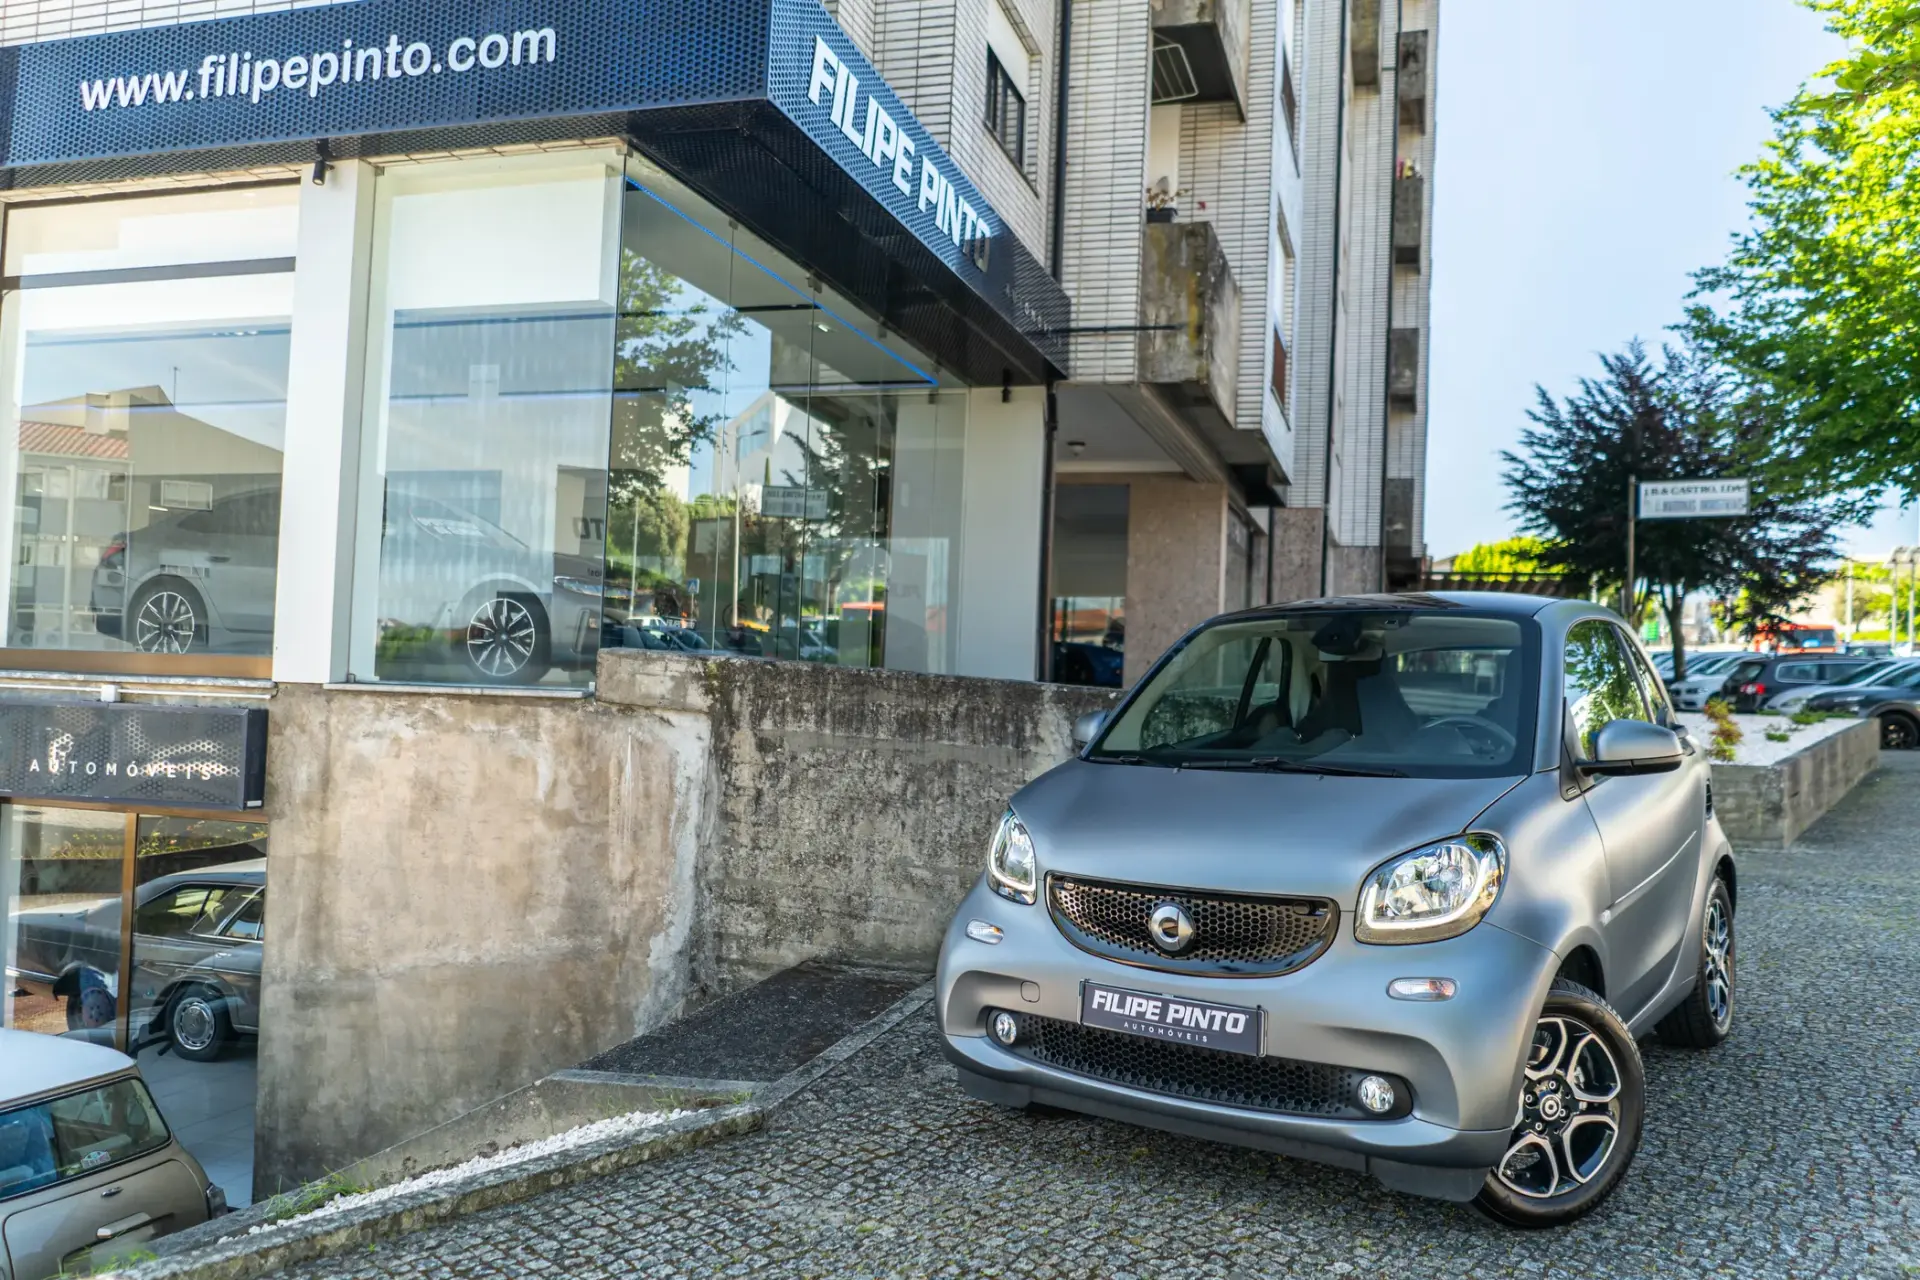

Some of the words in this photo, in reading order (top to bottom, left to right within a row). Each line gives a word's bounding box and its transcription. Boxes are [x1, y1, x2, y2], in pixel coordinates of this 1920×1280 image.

[80, 25, 557, 112] www.filipepinto.com
[807, 34, 915, 198] FILIPE
[917, 154, 992, 273] PINTO
[29, 759, 212, 781] AUTOMÓVEIS
[1092, 989, 1162, 1021] FILIPE
[1166, 1003, 1247, 1034] PINTO
[1124, 1021, 1207, 1043] AUTOMÓVEIS
